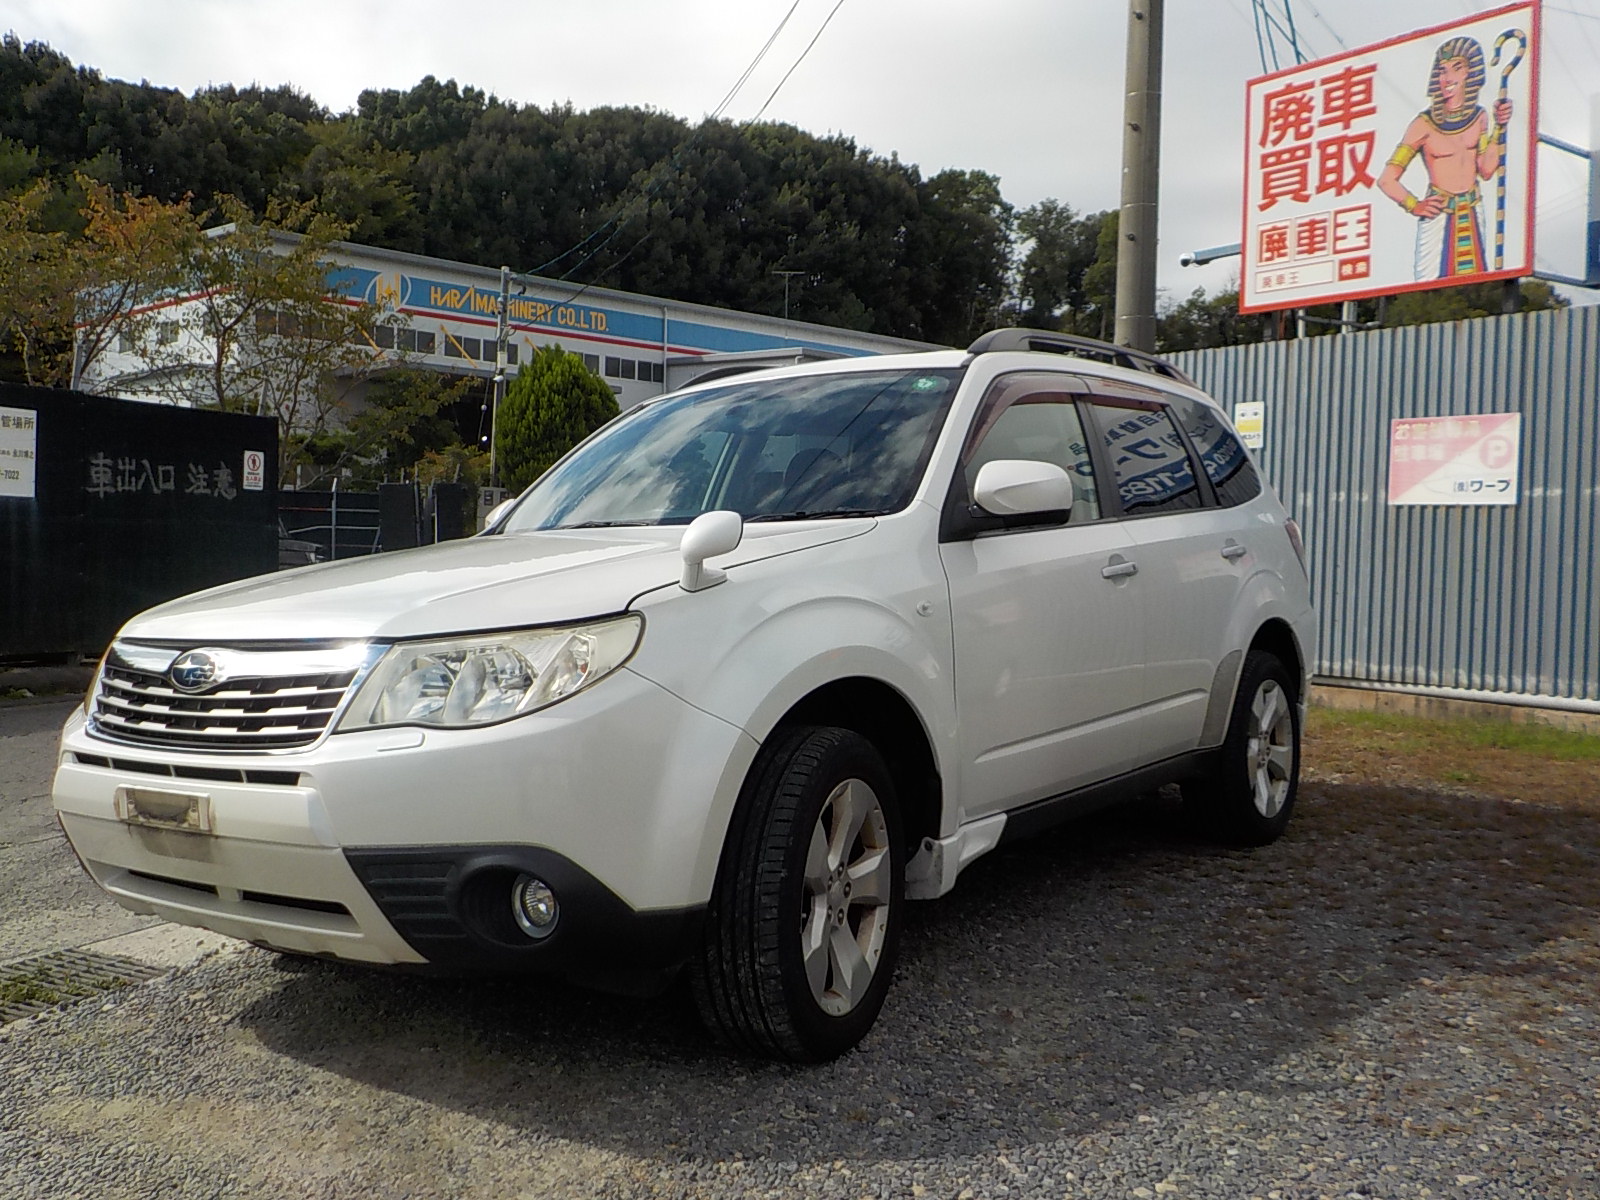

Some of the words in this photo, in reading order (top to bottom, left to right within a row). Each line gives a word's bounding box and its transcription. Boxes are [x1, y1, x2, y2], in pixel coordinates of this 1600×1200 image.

[1259, 63, 1378, 149] 廃車
[1257, 130, 1376, 212] 買取
[475, 294, 552, 323] MAHINERY
[0, 469, 20, 480] -7022
[86, 452, 175, 498] 車出入口
